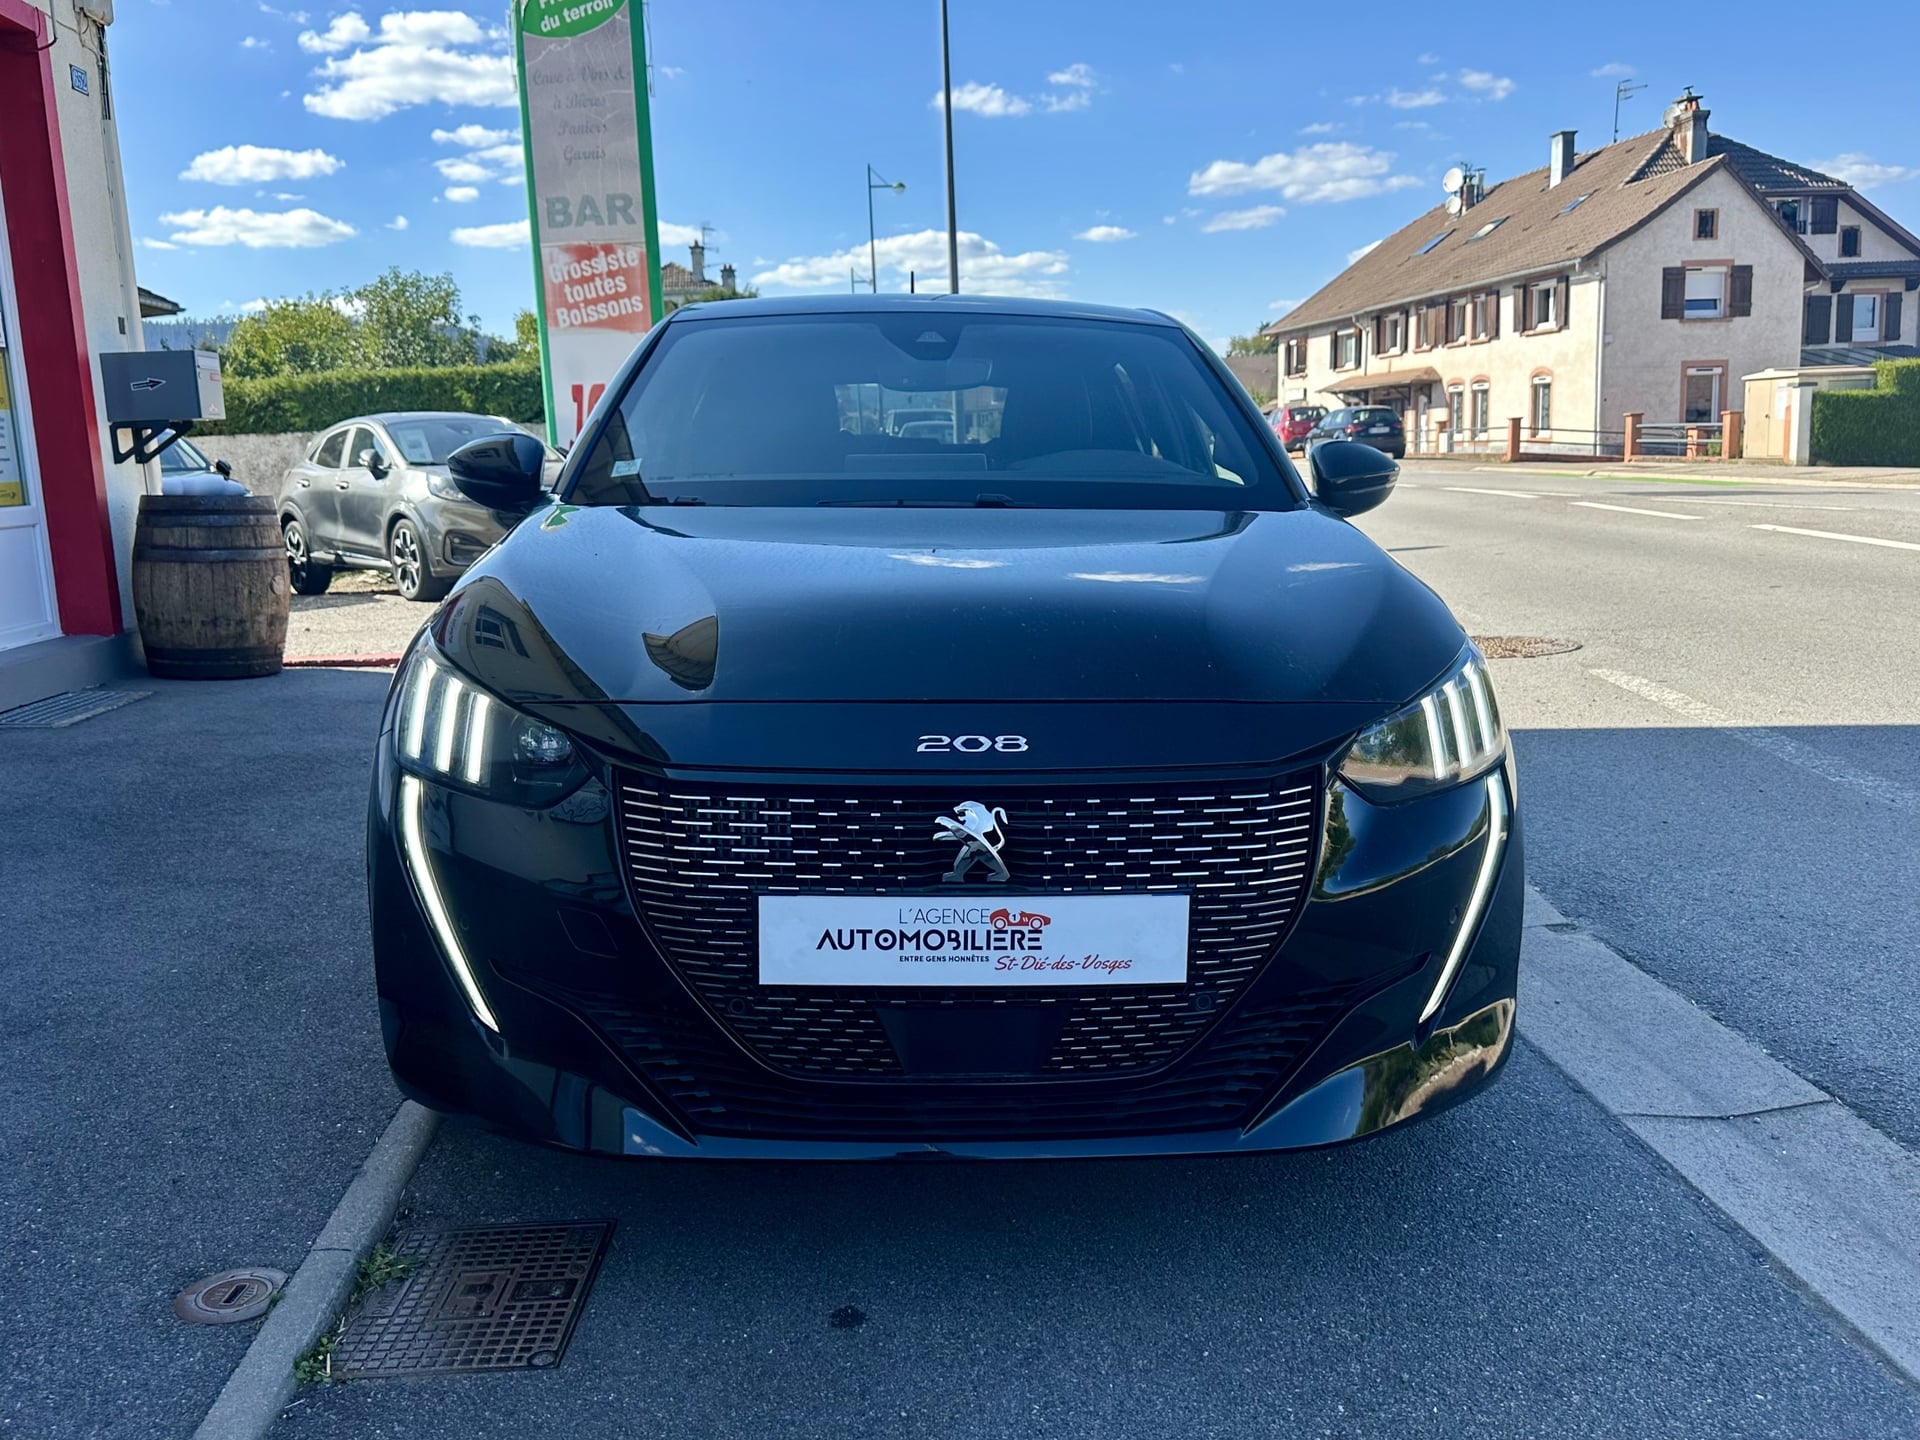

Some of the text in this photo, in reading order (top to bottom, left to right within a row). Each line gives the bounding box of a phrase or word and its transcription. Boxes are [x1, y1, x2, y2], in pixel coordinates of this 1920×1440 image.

[541, 14, 560, 32] du
[545, 192, 637, 229] BAR
[550, 250, 639, 284] Grossiste
[564, 275, 628, 304] toutes
[556, 295, 644, 329] Boissons
[917, 735, 1029, 752] 208
[899, 908, 990, 925] L'AGENCE
[816, 929, 1043, 951] AUTOMOBILIERE
[948, 954, 990, 963] HONNÊTES
[994, 954, 1132, 975] St-Dié-des-Vosges
